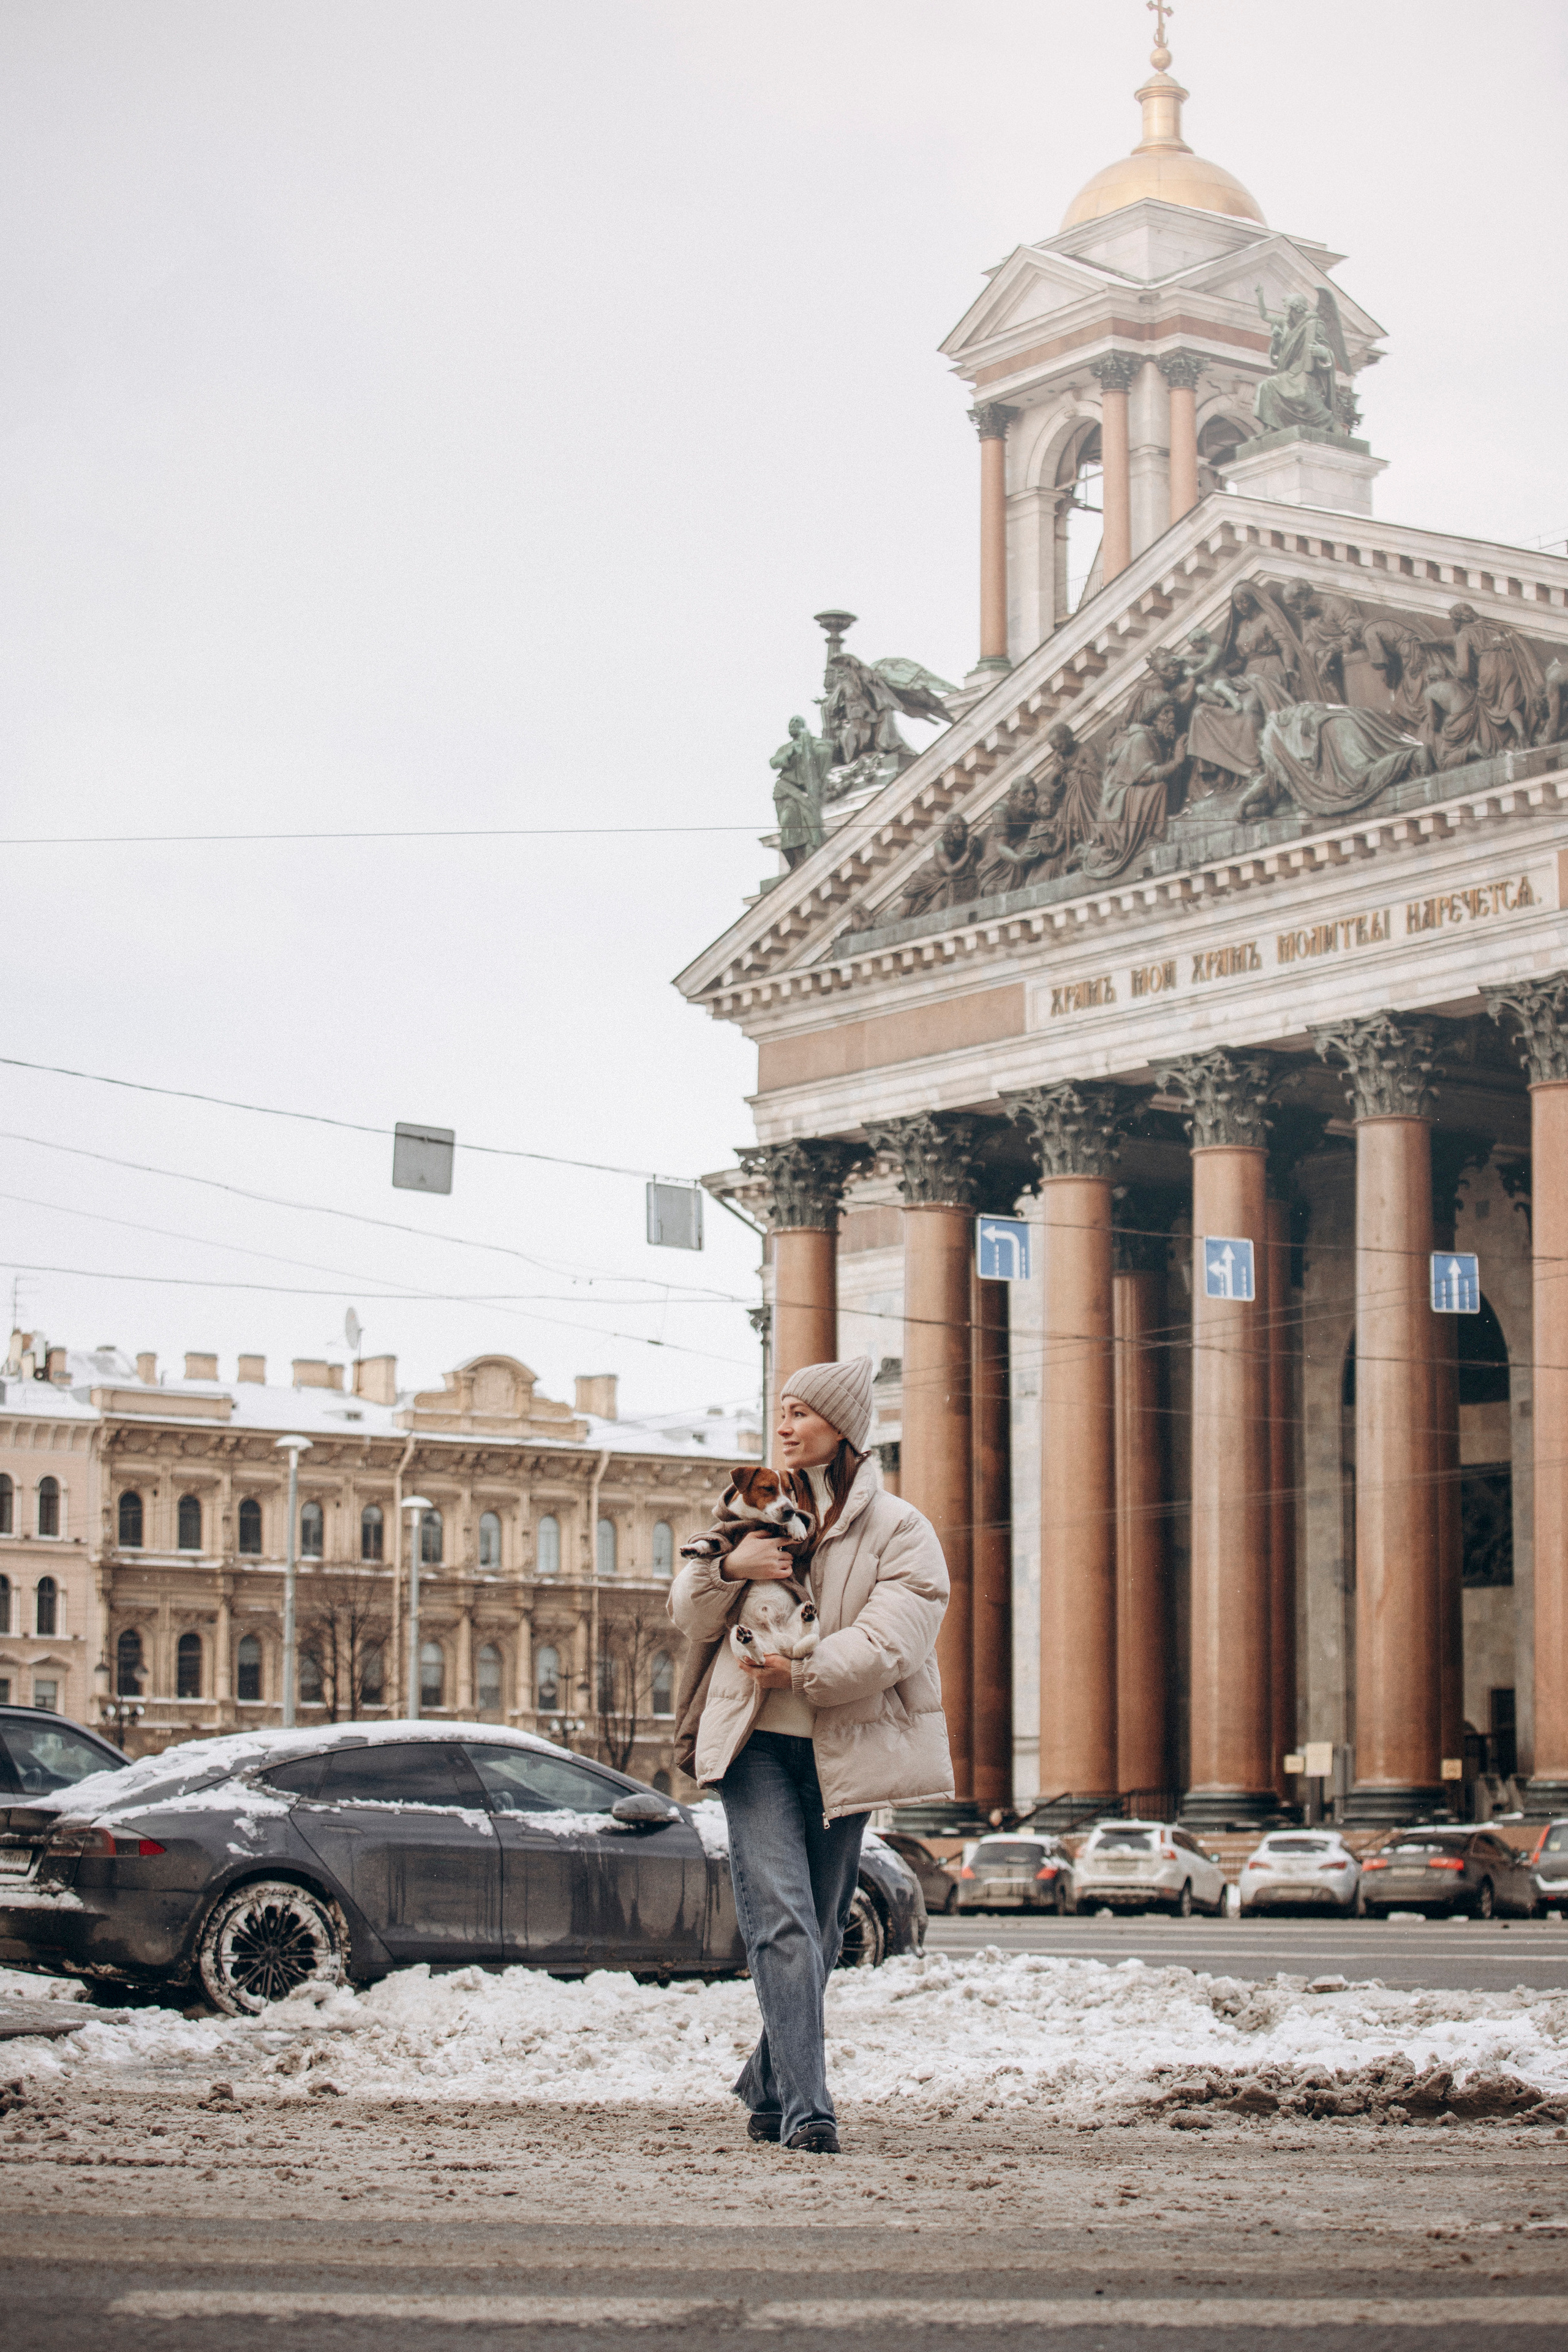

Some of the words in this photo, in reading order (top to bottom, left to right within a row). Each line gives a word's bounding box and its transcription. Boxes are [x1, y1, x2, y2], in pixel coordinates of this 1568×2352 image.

[1050, 975, 1117, 1017] ХРАМЪ
[1191, 941, 1262, 984] ХРАМЪ
[1277, 910, 1391, 964] МОЛИТВЫ
